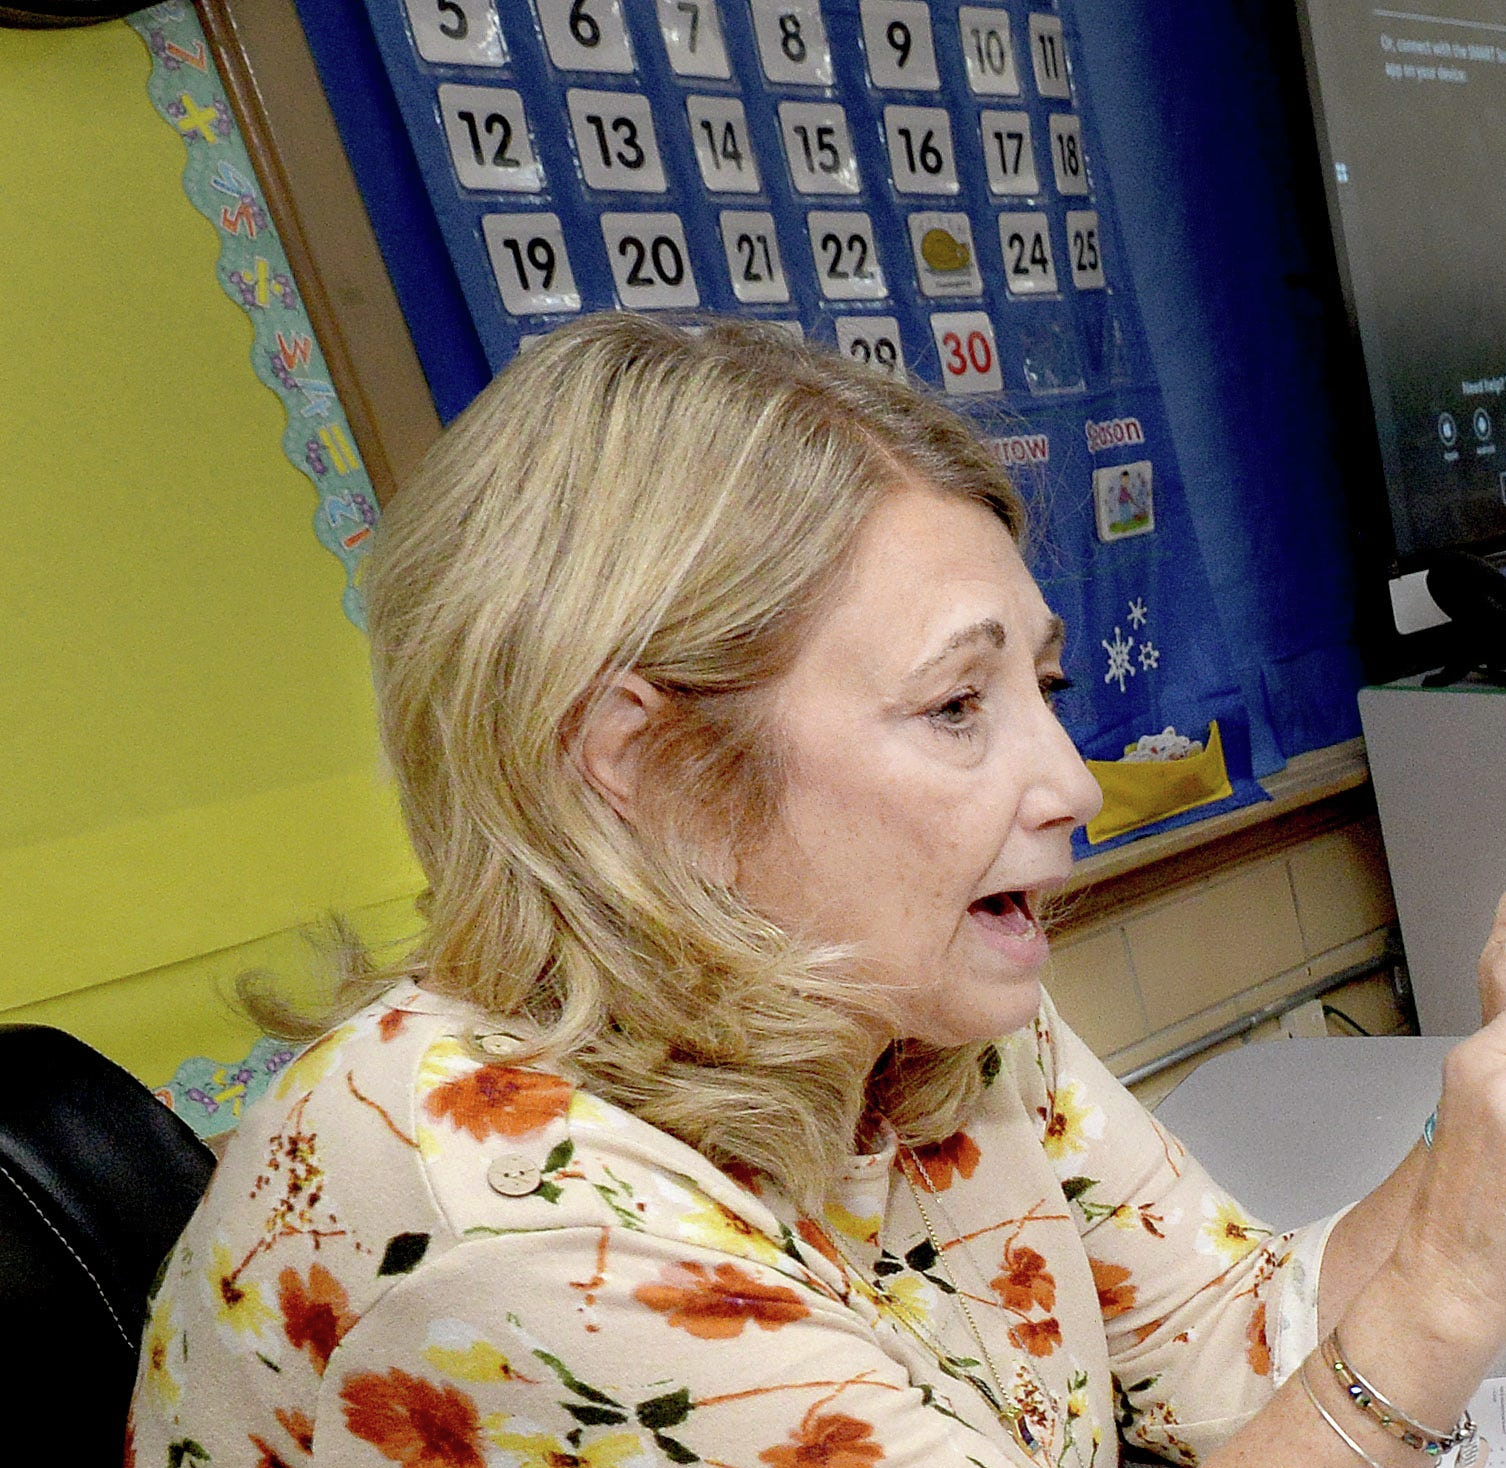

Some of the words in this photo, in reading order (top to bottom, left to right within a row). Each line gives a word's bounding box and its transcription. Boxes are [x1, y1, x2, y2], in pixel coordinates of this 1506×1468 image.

[569, 0, 600, 48] 6
[677, 2, 699, 53] 7
[779, 14, 807, 63] 8
[886, 21, 912, 67] 9
[971, 29, 1005, 75] 10
[1038, 35, 1059, 79] 11
[458, 111, 520, 168] 12
[587, 115, 645, 169] 13
[701, 120, 743, 171] 14
[793, 126, 841, 174] 15
[898, 128, 943, 174] 16
[994, 132, 1023, 175] 17
[1057, 134, 1079, 176] 18
[503, 237, 556, 290] 19
[619, 236, 684, 286] 20
[737, 234, 780, 284] 21
[821, 233, 874, 280] 22
[1009, 232, 1049, 275] 24
[1073, 230, 1098, 271] 25
[942, 330, 993, 376] 30
